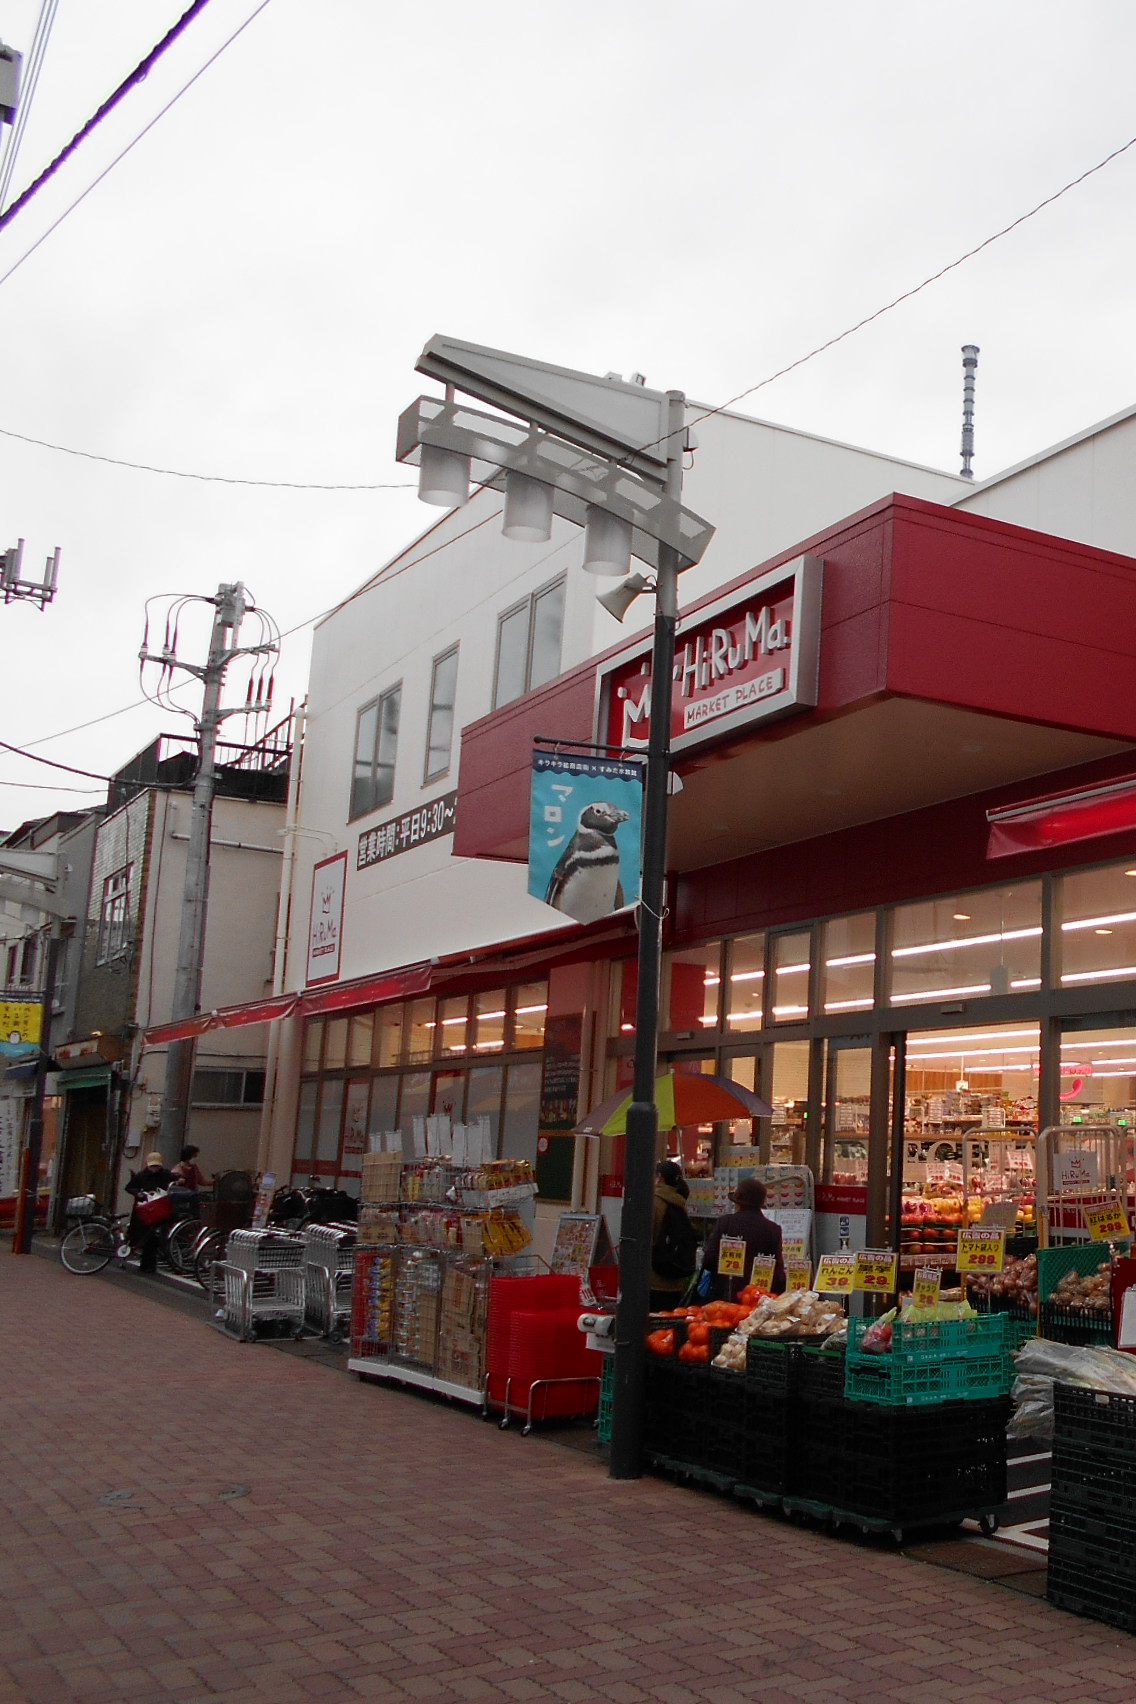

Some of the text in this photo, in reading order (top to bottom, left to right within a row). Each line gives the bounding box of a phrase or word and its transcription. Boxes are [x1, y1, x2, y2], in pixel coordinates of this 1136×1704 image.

[687, 676, 773, 724] MARKET PLACE
[543, 784, 574, 847] マロン
